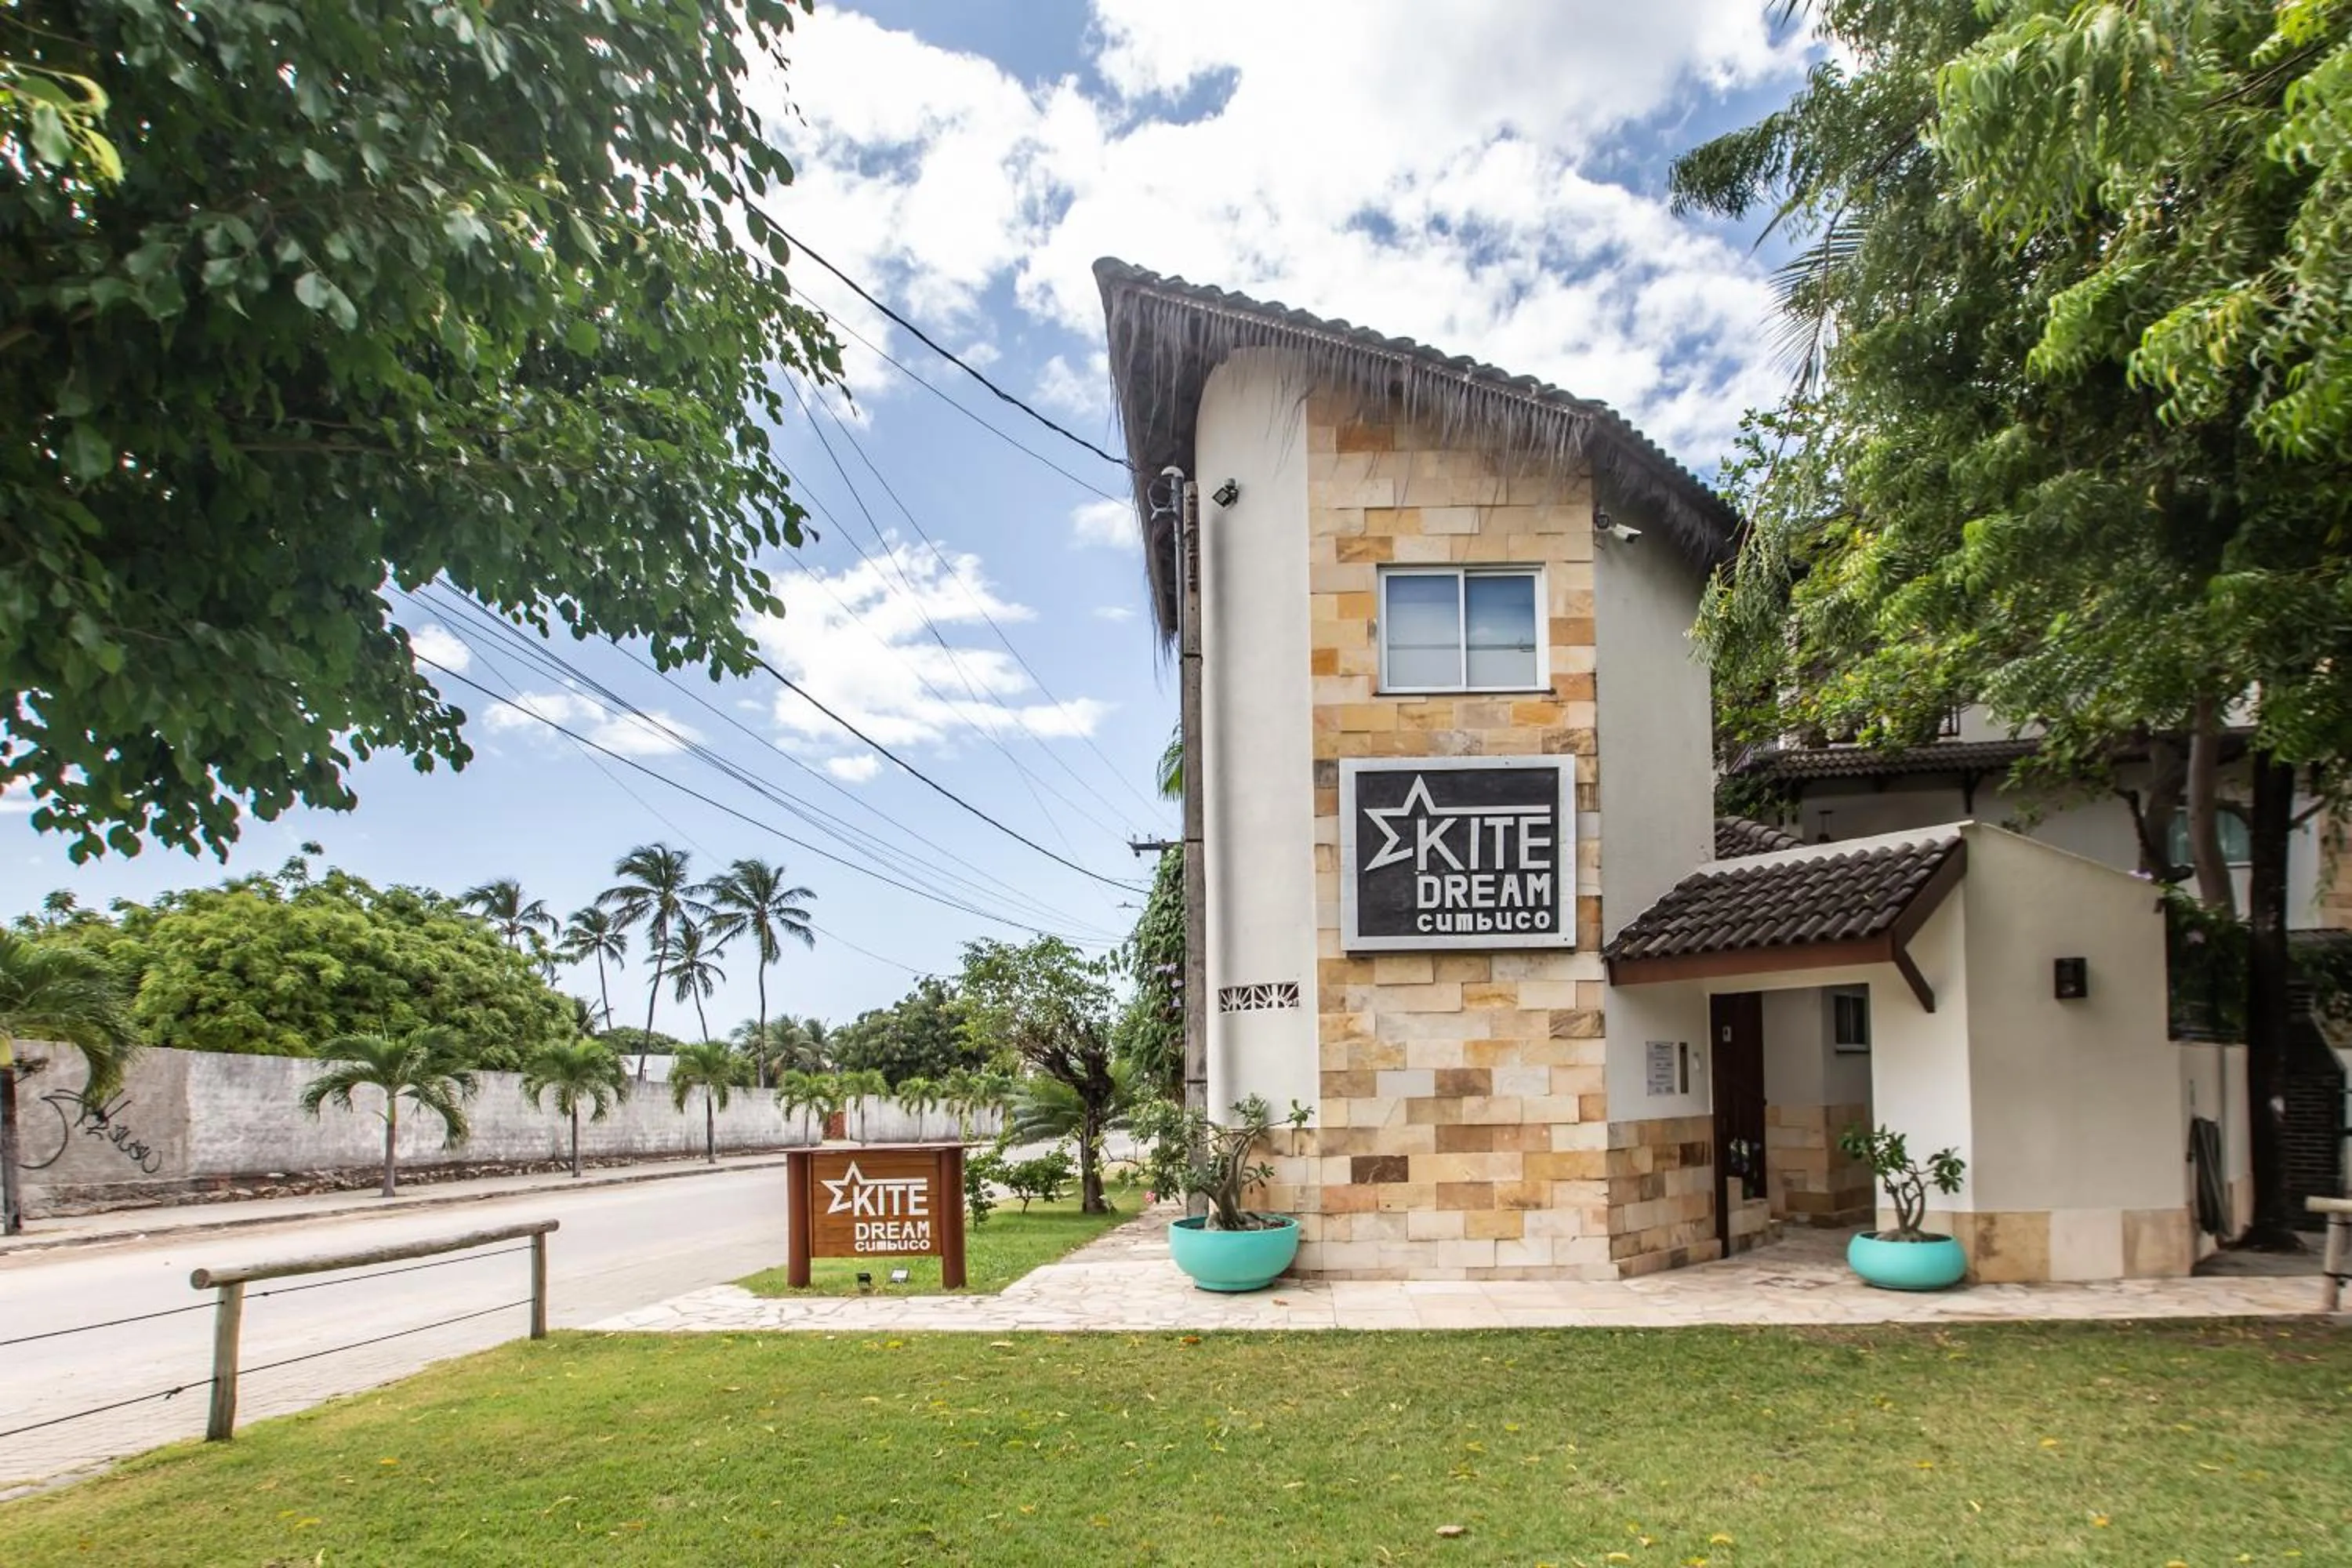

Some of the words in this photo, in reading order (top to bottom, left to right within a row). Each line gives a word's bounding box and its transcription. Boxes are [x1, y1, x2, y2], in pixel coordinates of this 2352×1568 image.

[1417, 816, 1552, 871] KITE
[1417, 873, 1551, 909] DREAM
[1417, 911, 1551, 932] cumbuco
[853, 1185, 929, 1216] KITE
[855, 1221, 931, 1240] DREAM
